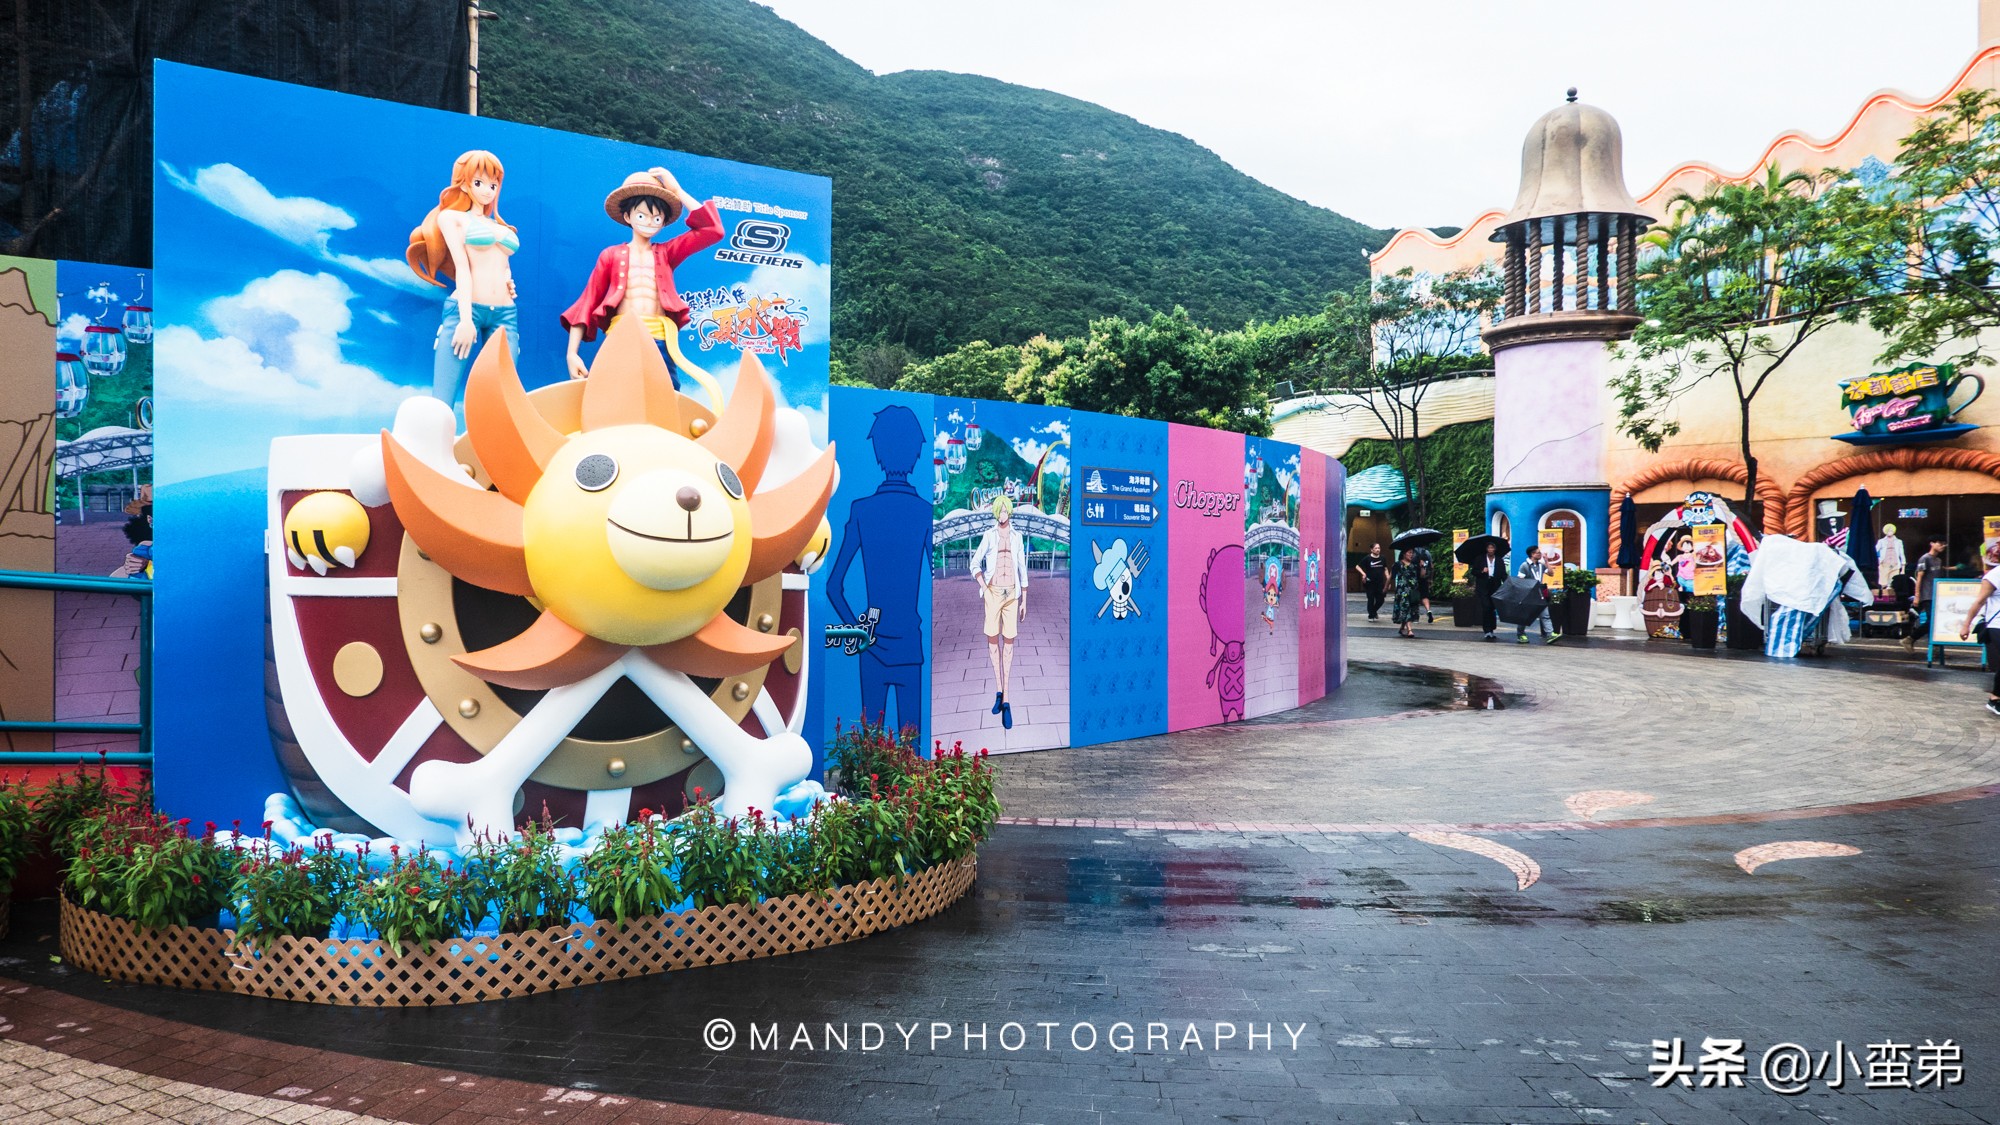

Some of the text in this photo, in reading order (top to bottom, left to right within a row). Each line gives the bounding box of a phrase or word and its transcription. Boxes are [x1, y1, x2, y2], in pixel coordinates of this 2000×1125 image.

[753, 203, 774, 214] Title
[774, 206, 808, 220] Sponsor
[715, 249, 803, 269] SKECHERS
[1133, 486, 1150, 494] Aquarium
[1174, 480, 1240, 517] Chopper
[1123, 513, 1150, 522] Souvenir Shop
